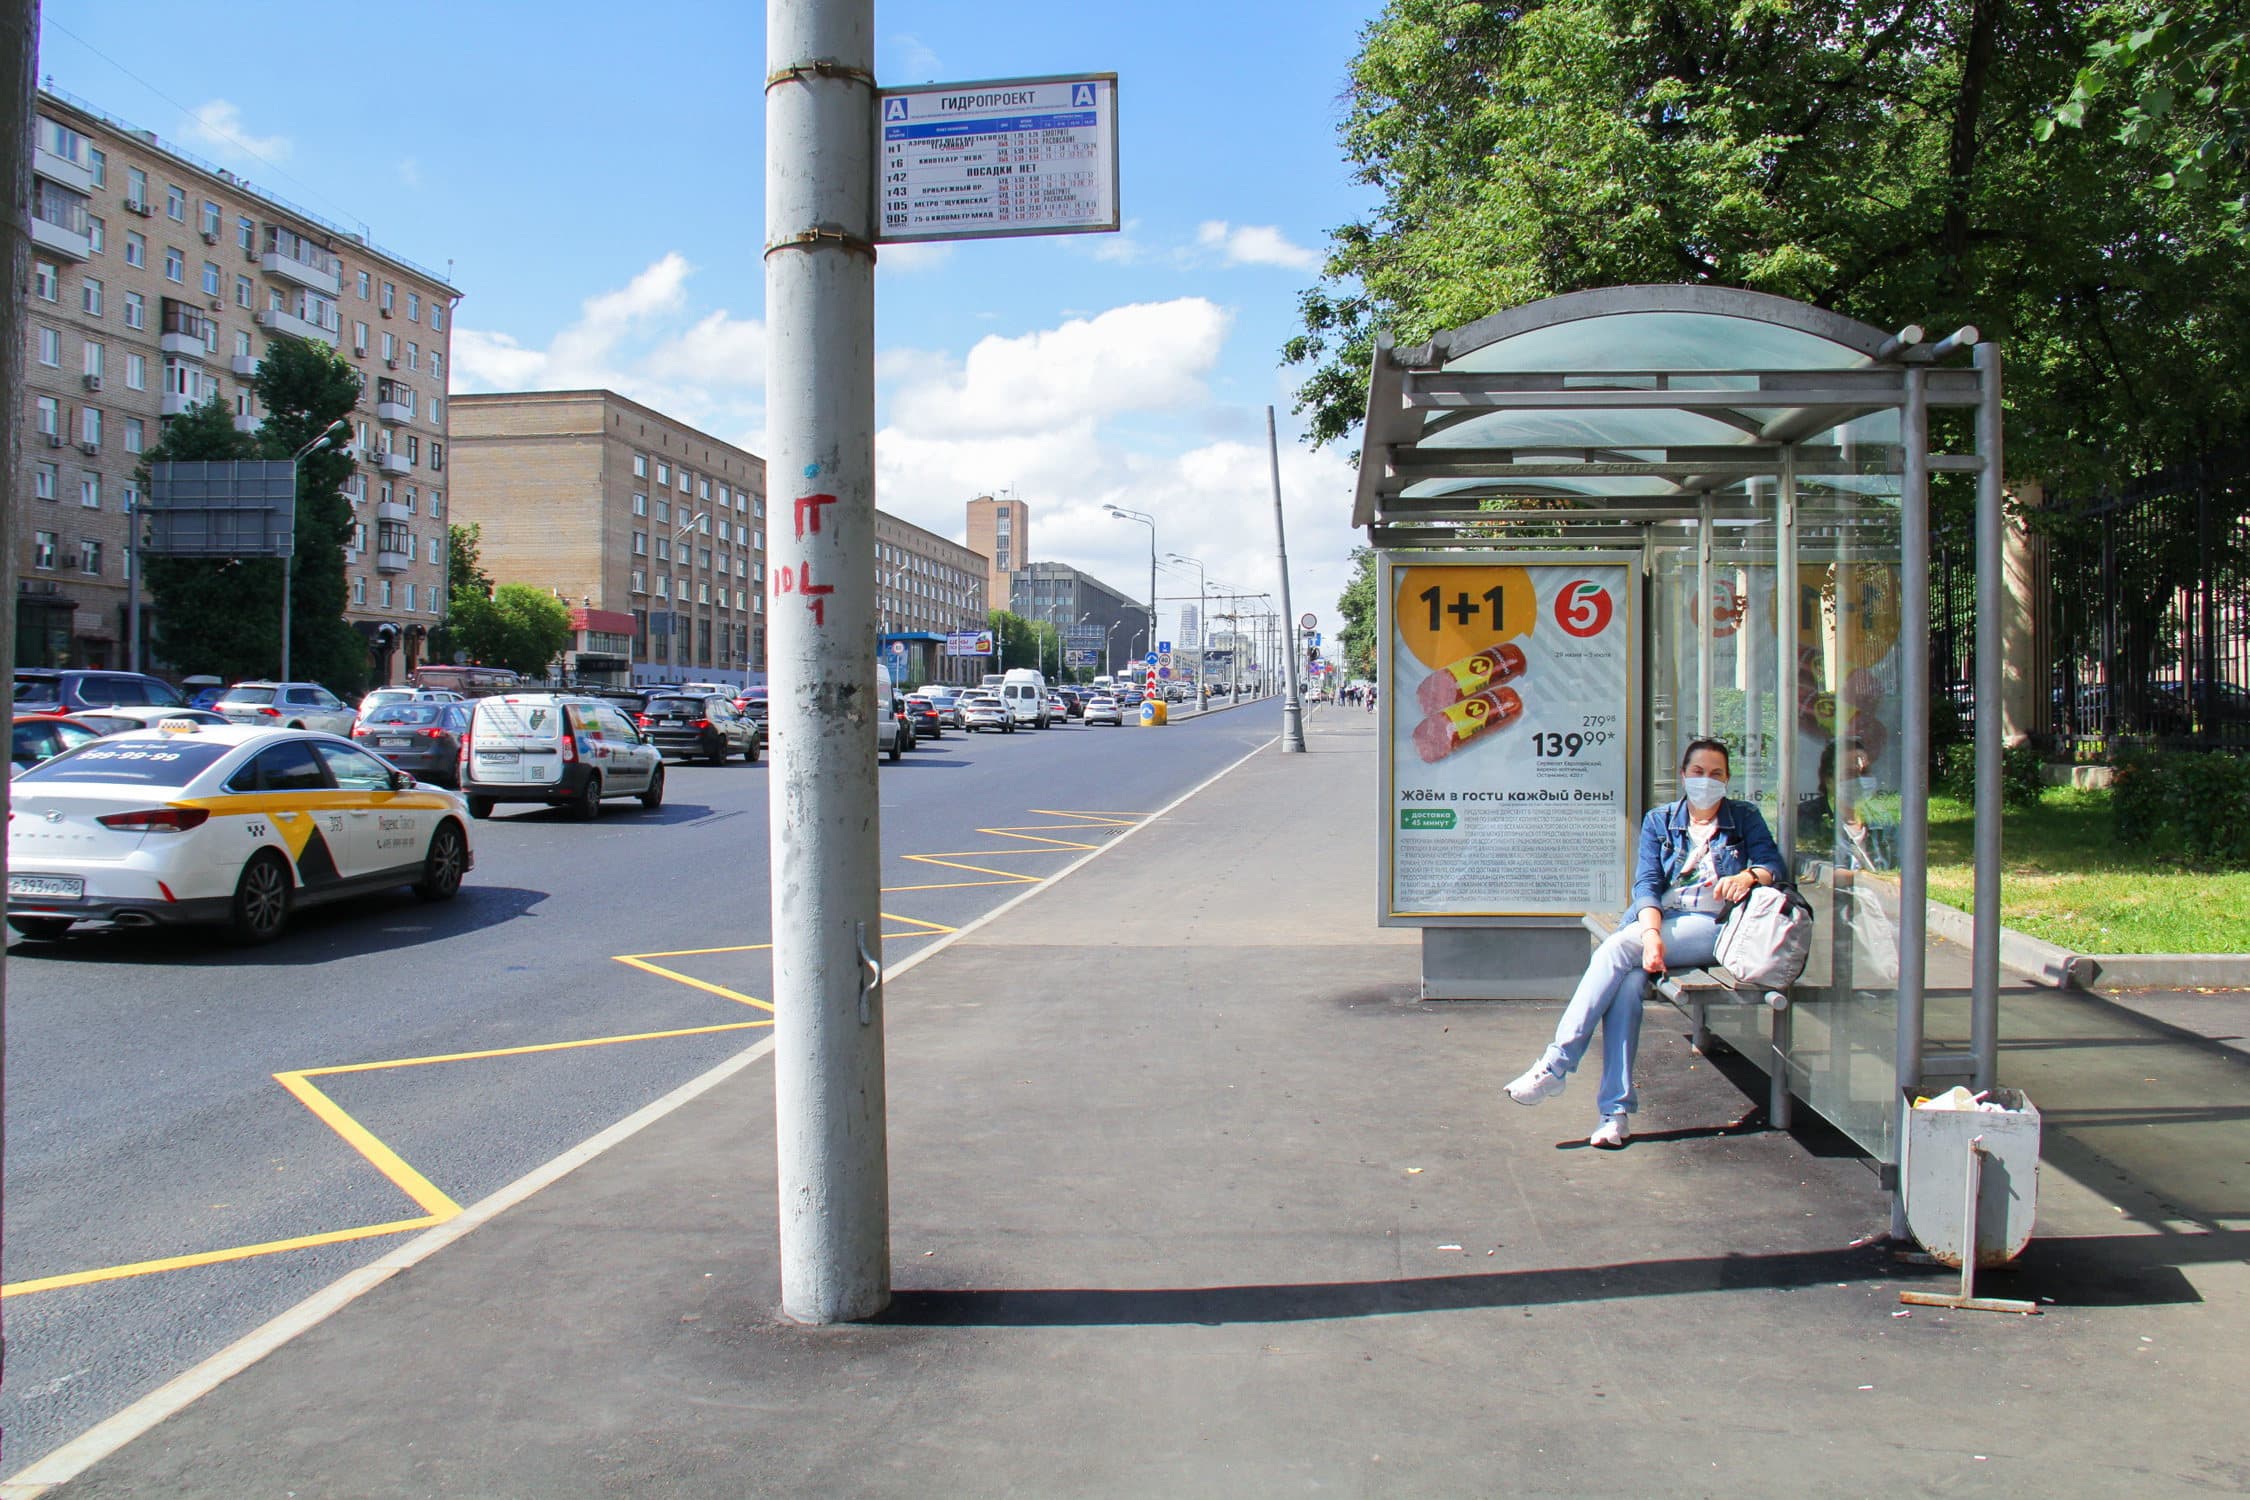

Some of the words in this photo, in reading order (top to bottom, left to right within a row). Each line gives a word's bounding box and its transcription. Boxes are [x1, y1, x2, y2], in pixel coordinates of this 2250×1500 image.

[941, 91, 1035, 111] ГИДРОПРОЕКТ
[967, 165, 1012, 177] ПОСАДКИ
[1020, 164, 1036, 173] НЕТ
[887, 187, 907, 197] т43
[887, 201, 907, 211] 105
[914, 200, 939, 208] МЕТРО
[887, 214, 907, 224] 905
[971, 211, 993, 219] МКАД
[1420, 585, 1504, 631] 1+1
[75, 750, 180, 762] 999-99-99
[1401, 789, 1445, 801] Ждём
[1450, 792, 1458, 801] в
[1462, 792, 1503, 801] гости
[1508, 789, 1569, 801] каждый
[1574, 789, 1614, 801] день!
[1411, 811, 1451, 819] доставка
